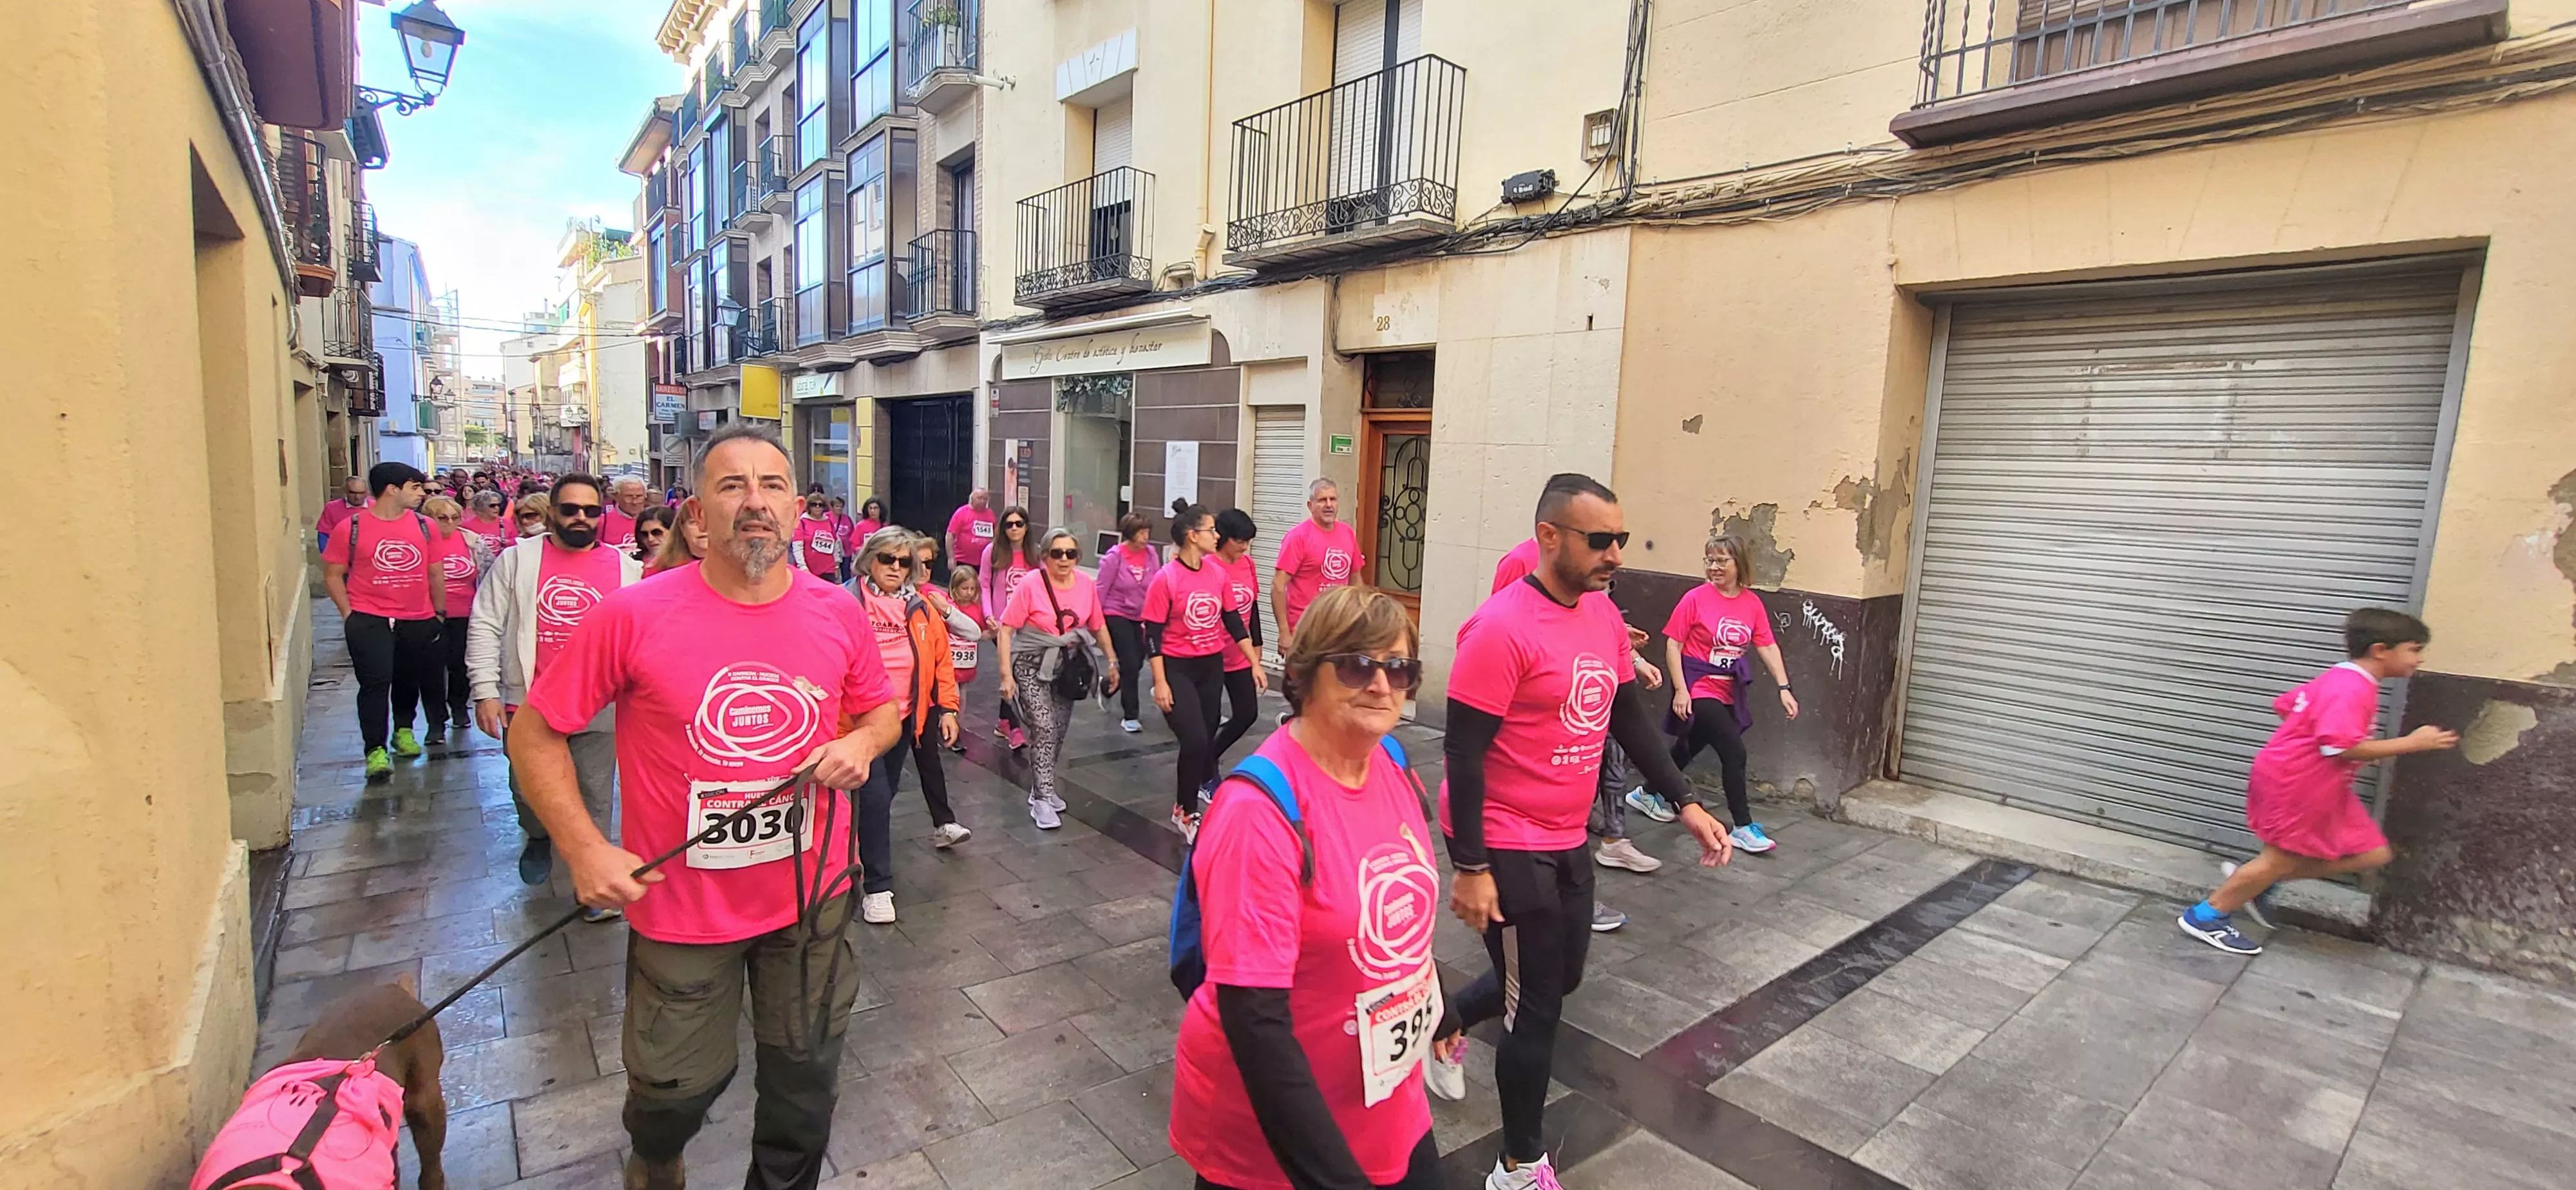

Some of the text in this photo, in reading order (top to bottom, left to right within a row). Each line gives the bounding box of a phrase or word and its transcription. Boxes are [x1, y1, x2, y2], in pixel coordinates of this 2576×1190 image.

[1376, 316, 1390, 331] 28
[1117, 347, 1126, 365] y
[951, 651, 974, 661] 2938
[732, 713, 769, 727] JUNTOS
[706, 799, 752, 808] CONTRA
[702, 805, 805, 844] 3030
